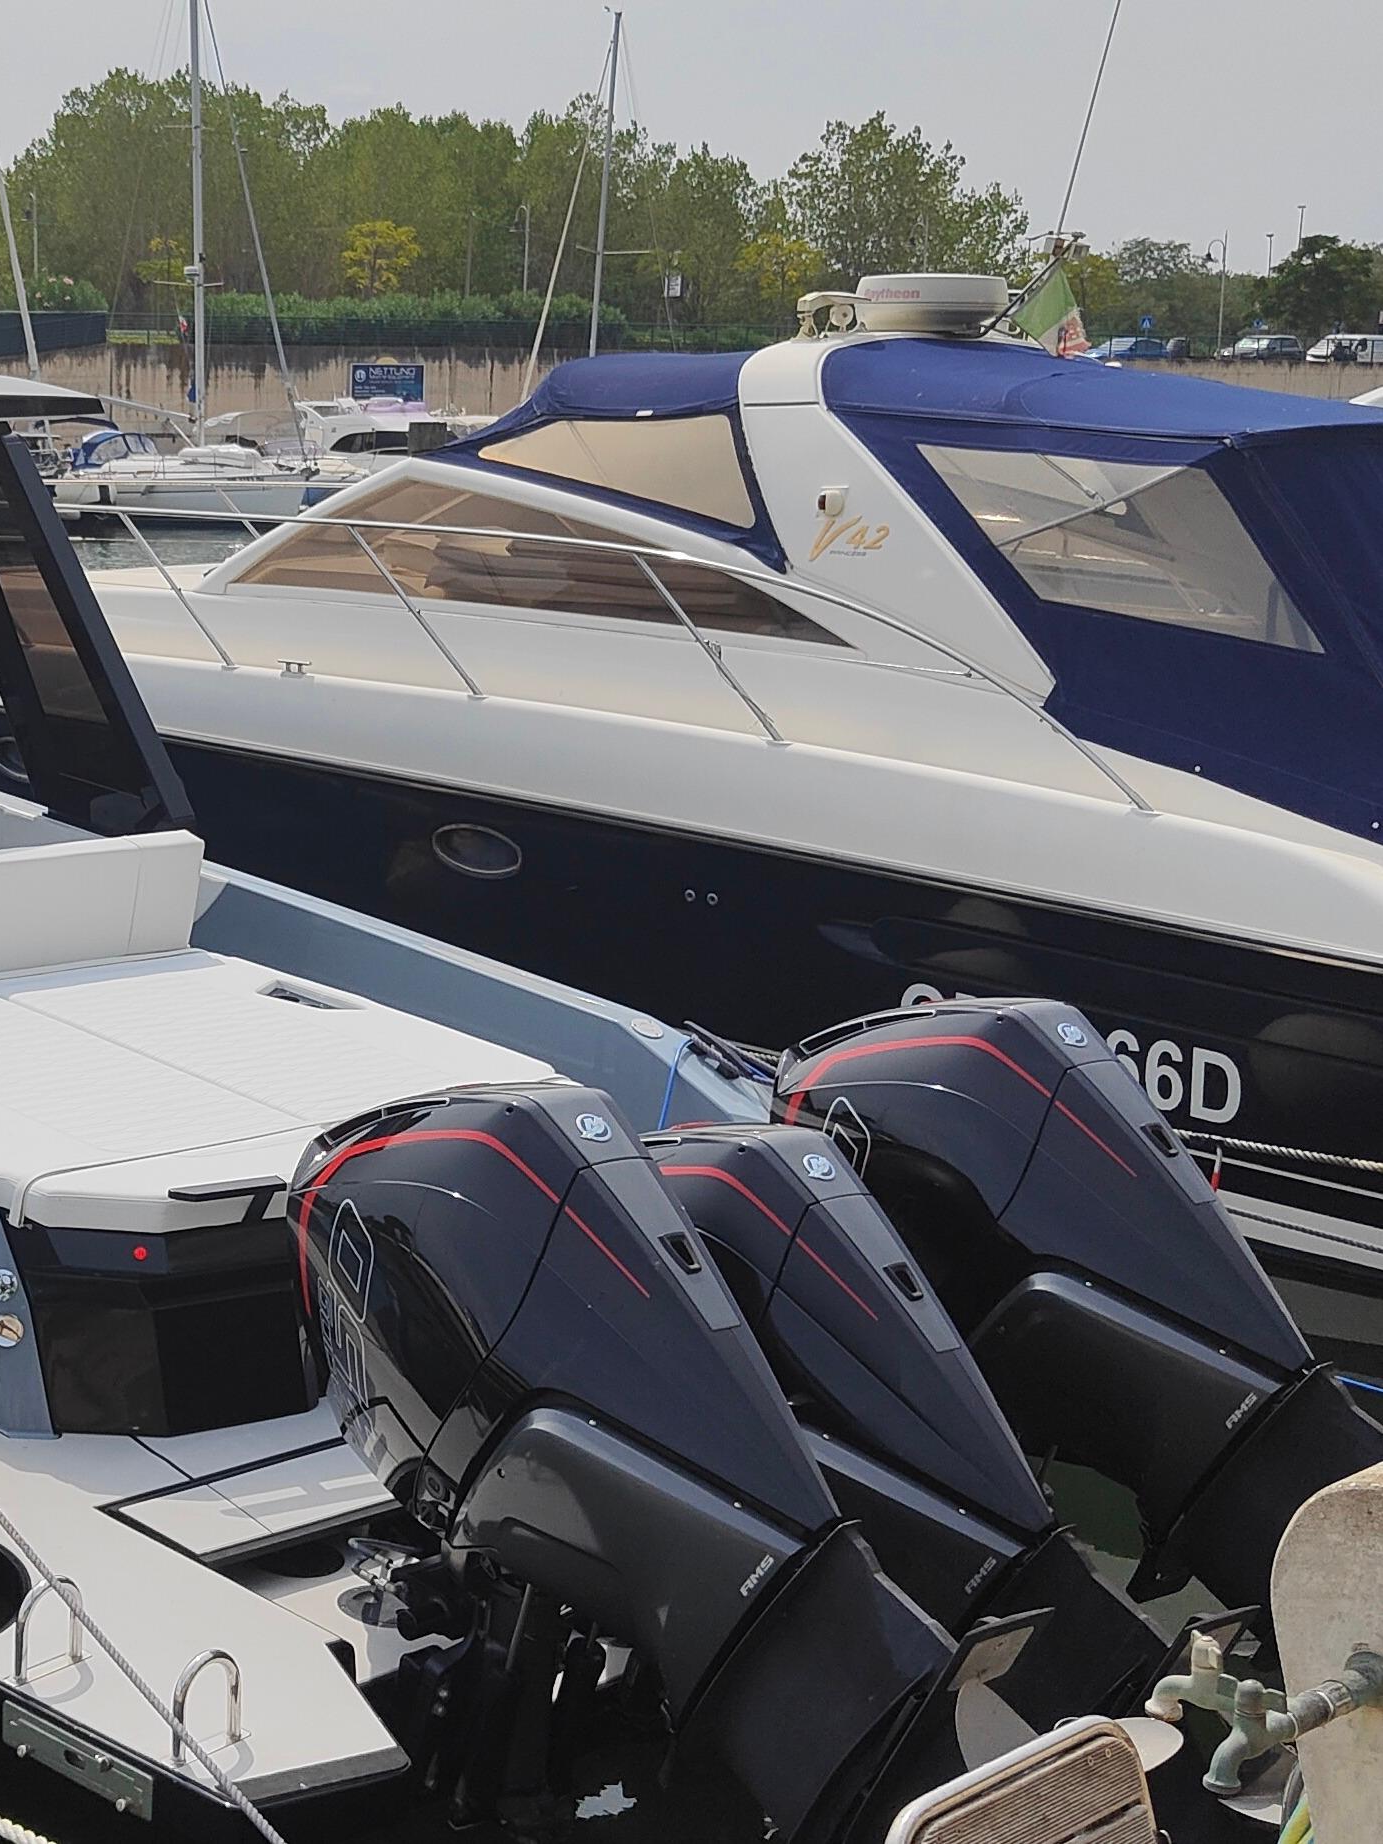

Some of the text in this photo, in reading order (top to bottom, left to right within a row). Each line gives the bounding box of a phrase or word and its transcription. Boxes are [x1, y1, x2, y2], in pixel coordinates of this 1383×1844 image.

[369, 367, 416, 376] NETTUNO
[1226, 1392, 1257, 1430] AMS
[740, 1554, 774, 1597] AMS
[965, 1556, 997, 1594] AMS
